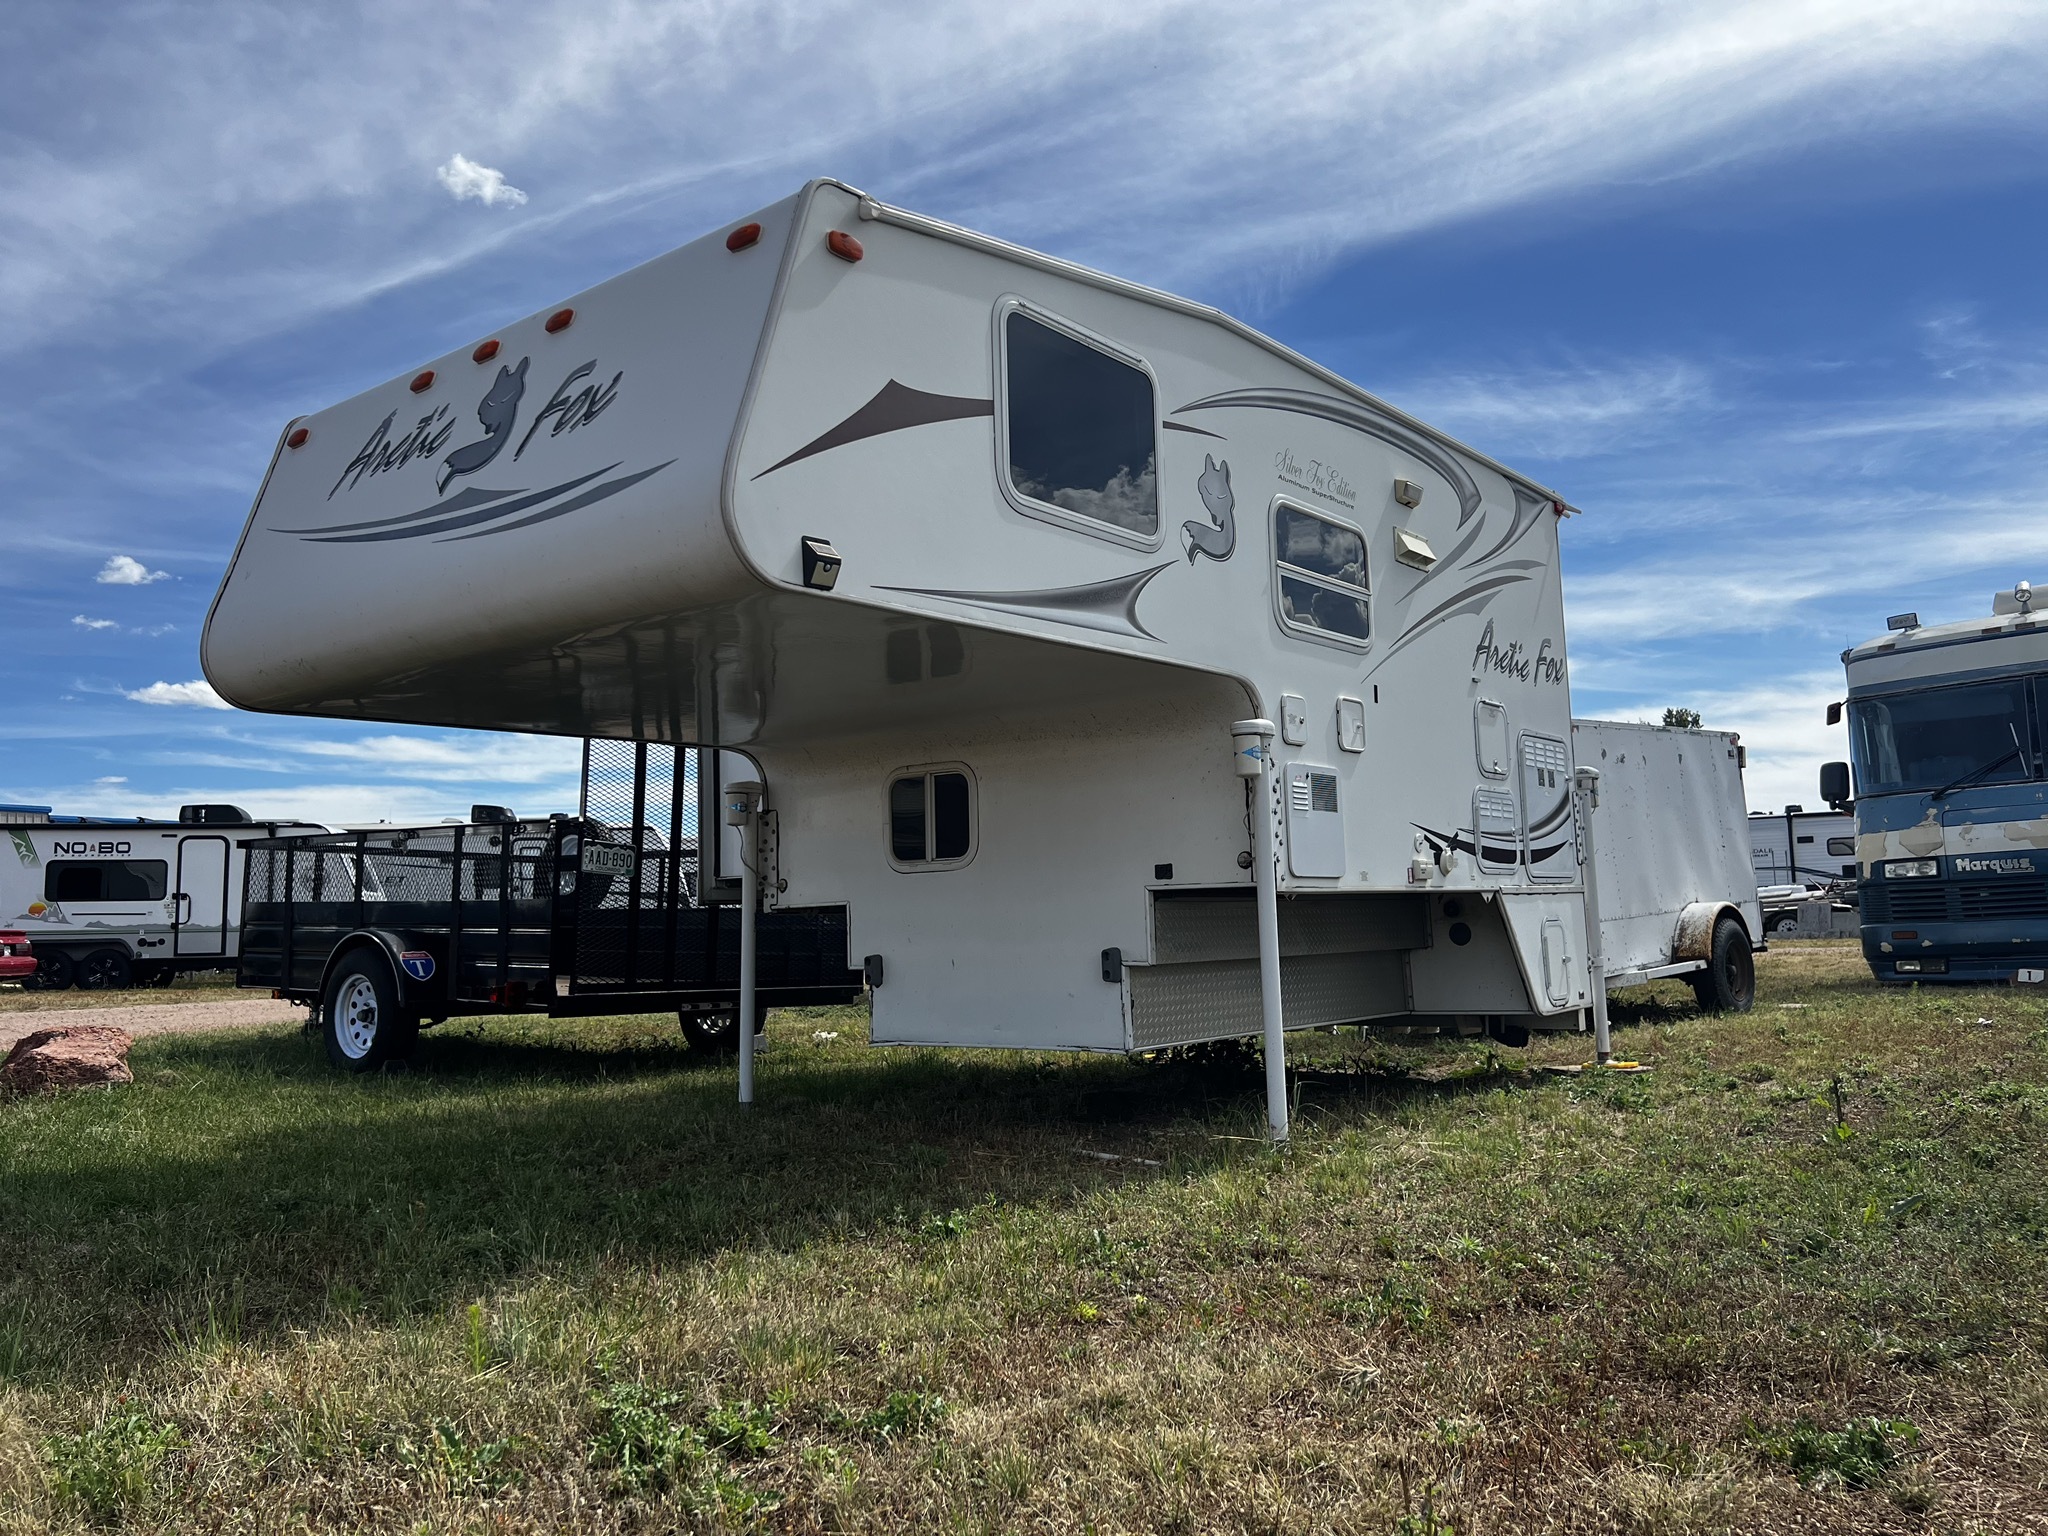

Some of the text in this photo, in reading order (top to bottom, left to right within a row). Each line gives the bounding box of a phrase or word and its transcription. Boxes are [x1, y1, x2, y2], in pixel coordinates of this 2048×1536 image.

[327, 358, 624, 501] Arctic Fox
[1274, 447, 1303, 479] Silver
[1326, 465, 1357, 502] Edition
[1277, 473, 1311, 492] Aluminum
[1472, 617, 1565, 688] Arctic Fox
[1955, 858, 2036, 874] Marquis
